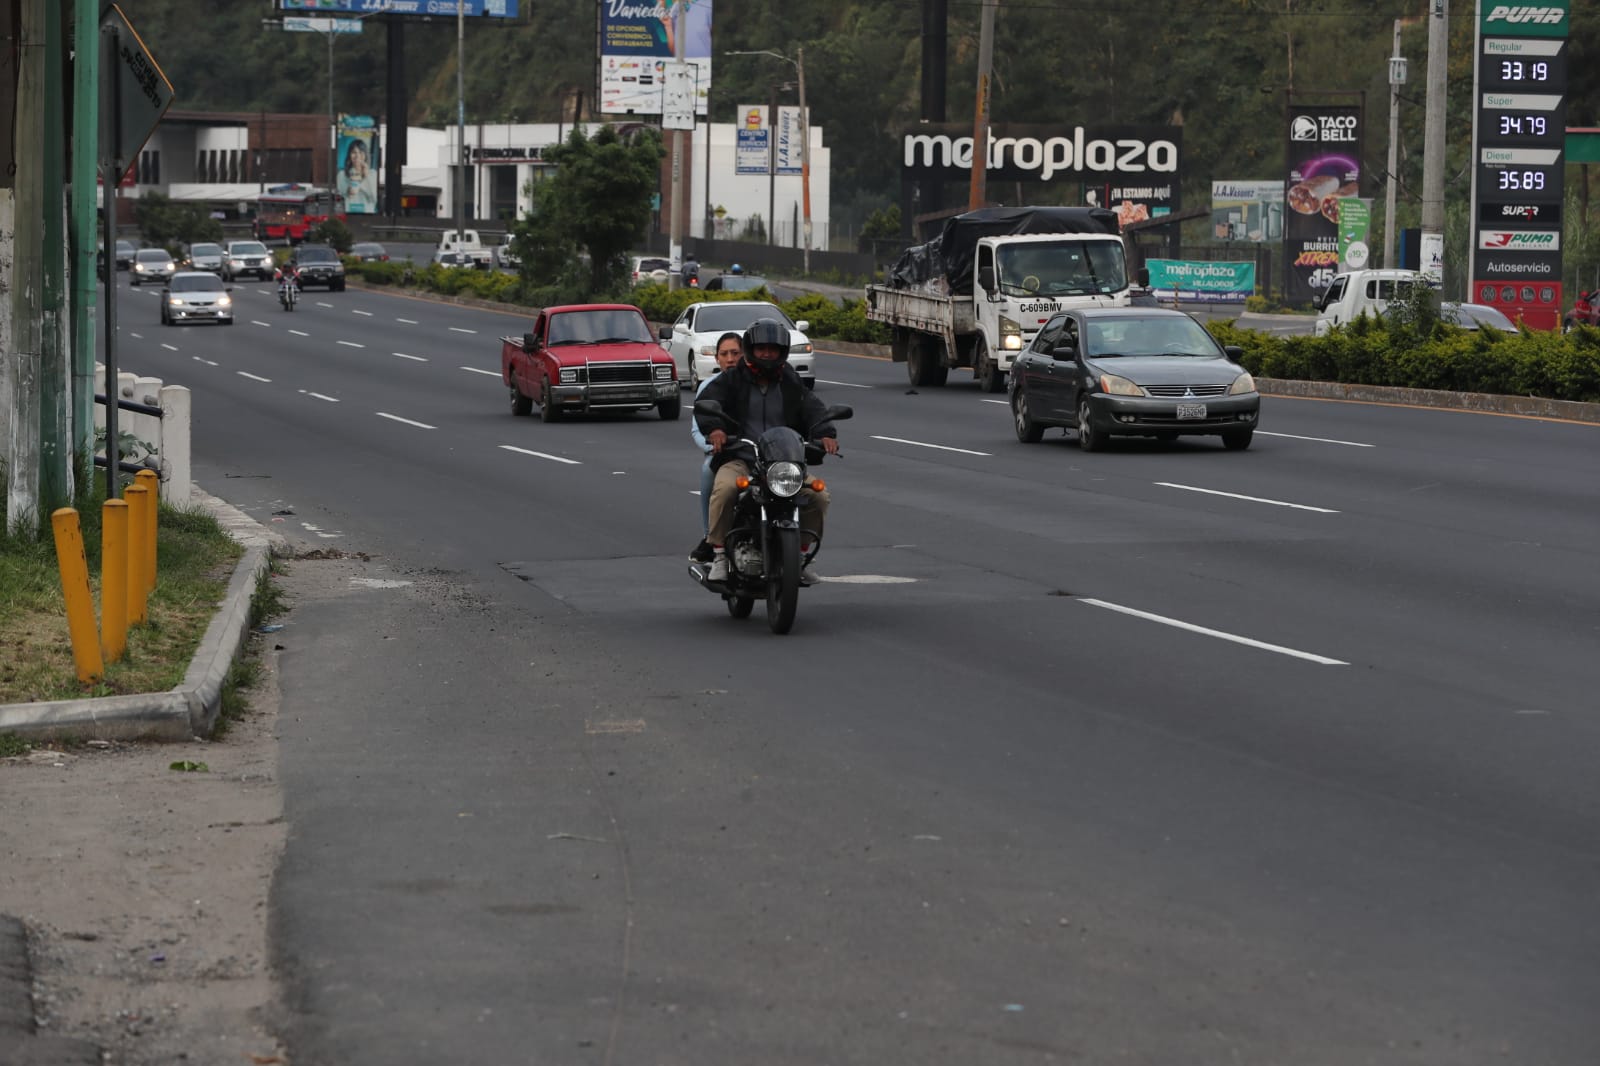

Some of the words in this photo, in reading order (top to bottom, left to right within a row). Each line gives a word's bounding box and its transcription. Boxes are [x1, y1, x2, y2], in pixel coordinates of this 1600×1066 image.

[606, 0, 677, 19] Variedad
[1486, 6, 1565, 24] PUMA
[1489, 42, 1522, 52] Regular
[1502, 61, 1548, 80] 33.19
[1487, 96, 1513, 106] Super
[1318, 116, 1357, 129] TACO
[1500, 116, 1546, 135] 34.79
[1321, 129, 1357, 141] BELL
[904, 126, 1178, 181] metroplaza
[1486, 151, 1513, 161] Diesel
[1499, 171, 1545, 190] 35.89
[1122, 187, 1153, 199] ESTAMOS
[1510, 233, 1554, 243] PUMA
[1295, 251, 1339, 266] XTREM
[1166, 263, 1236, 278] metroplaza
[1487, 261, 1551, 273] Autoservicio
[1192, 279, 1235, 289] VILLALOBOS
[1020, 302, 1063, 313] C-609BMV
